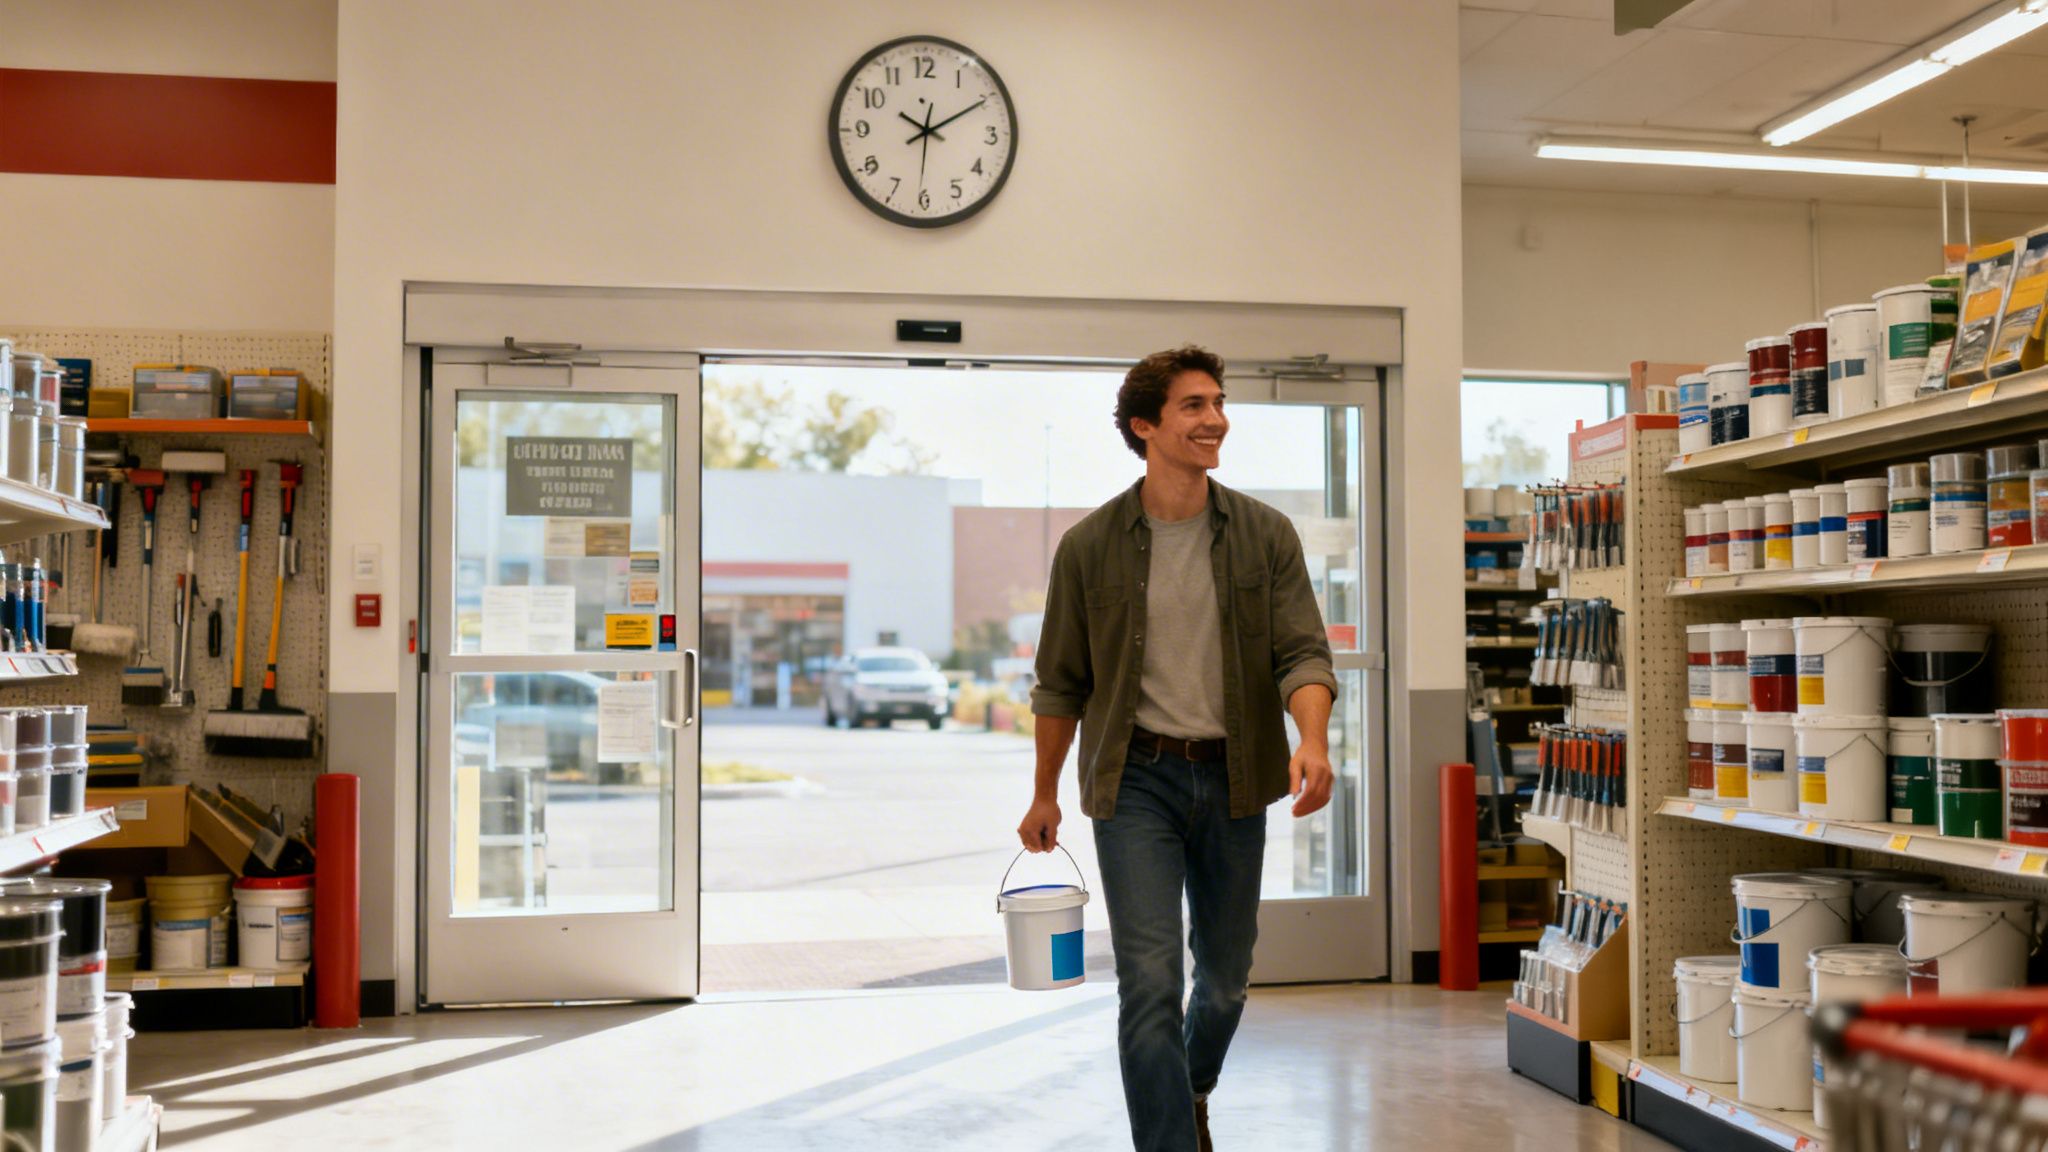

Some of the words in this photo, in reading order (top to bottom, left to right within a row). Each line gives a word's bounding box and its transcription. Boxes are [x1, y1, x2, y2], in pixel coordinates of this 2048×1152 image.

[886, 67, 900, 86] 11
[914, 56, 936, 79] 12
[956, 70, 961, 88] 1
[864, 87, 885, 109] 10
[855, 119, 870, 138] 9
[984, 126, 998, 145] 3
[970, 157, 983, 176] 4
[886, 177, 902, 203] 7
[950, 179, 964, 199] 5
[918, 189, 930, 210] 6
